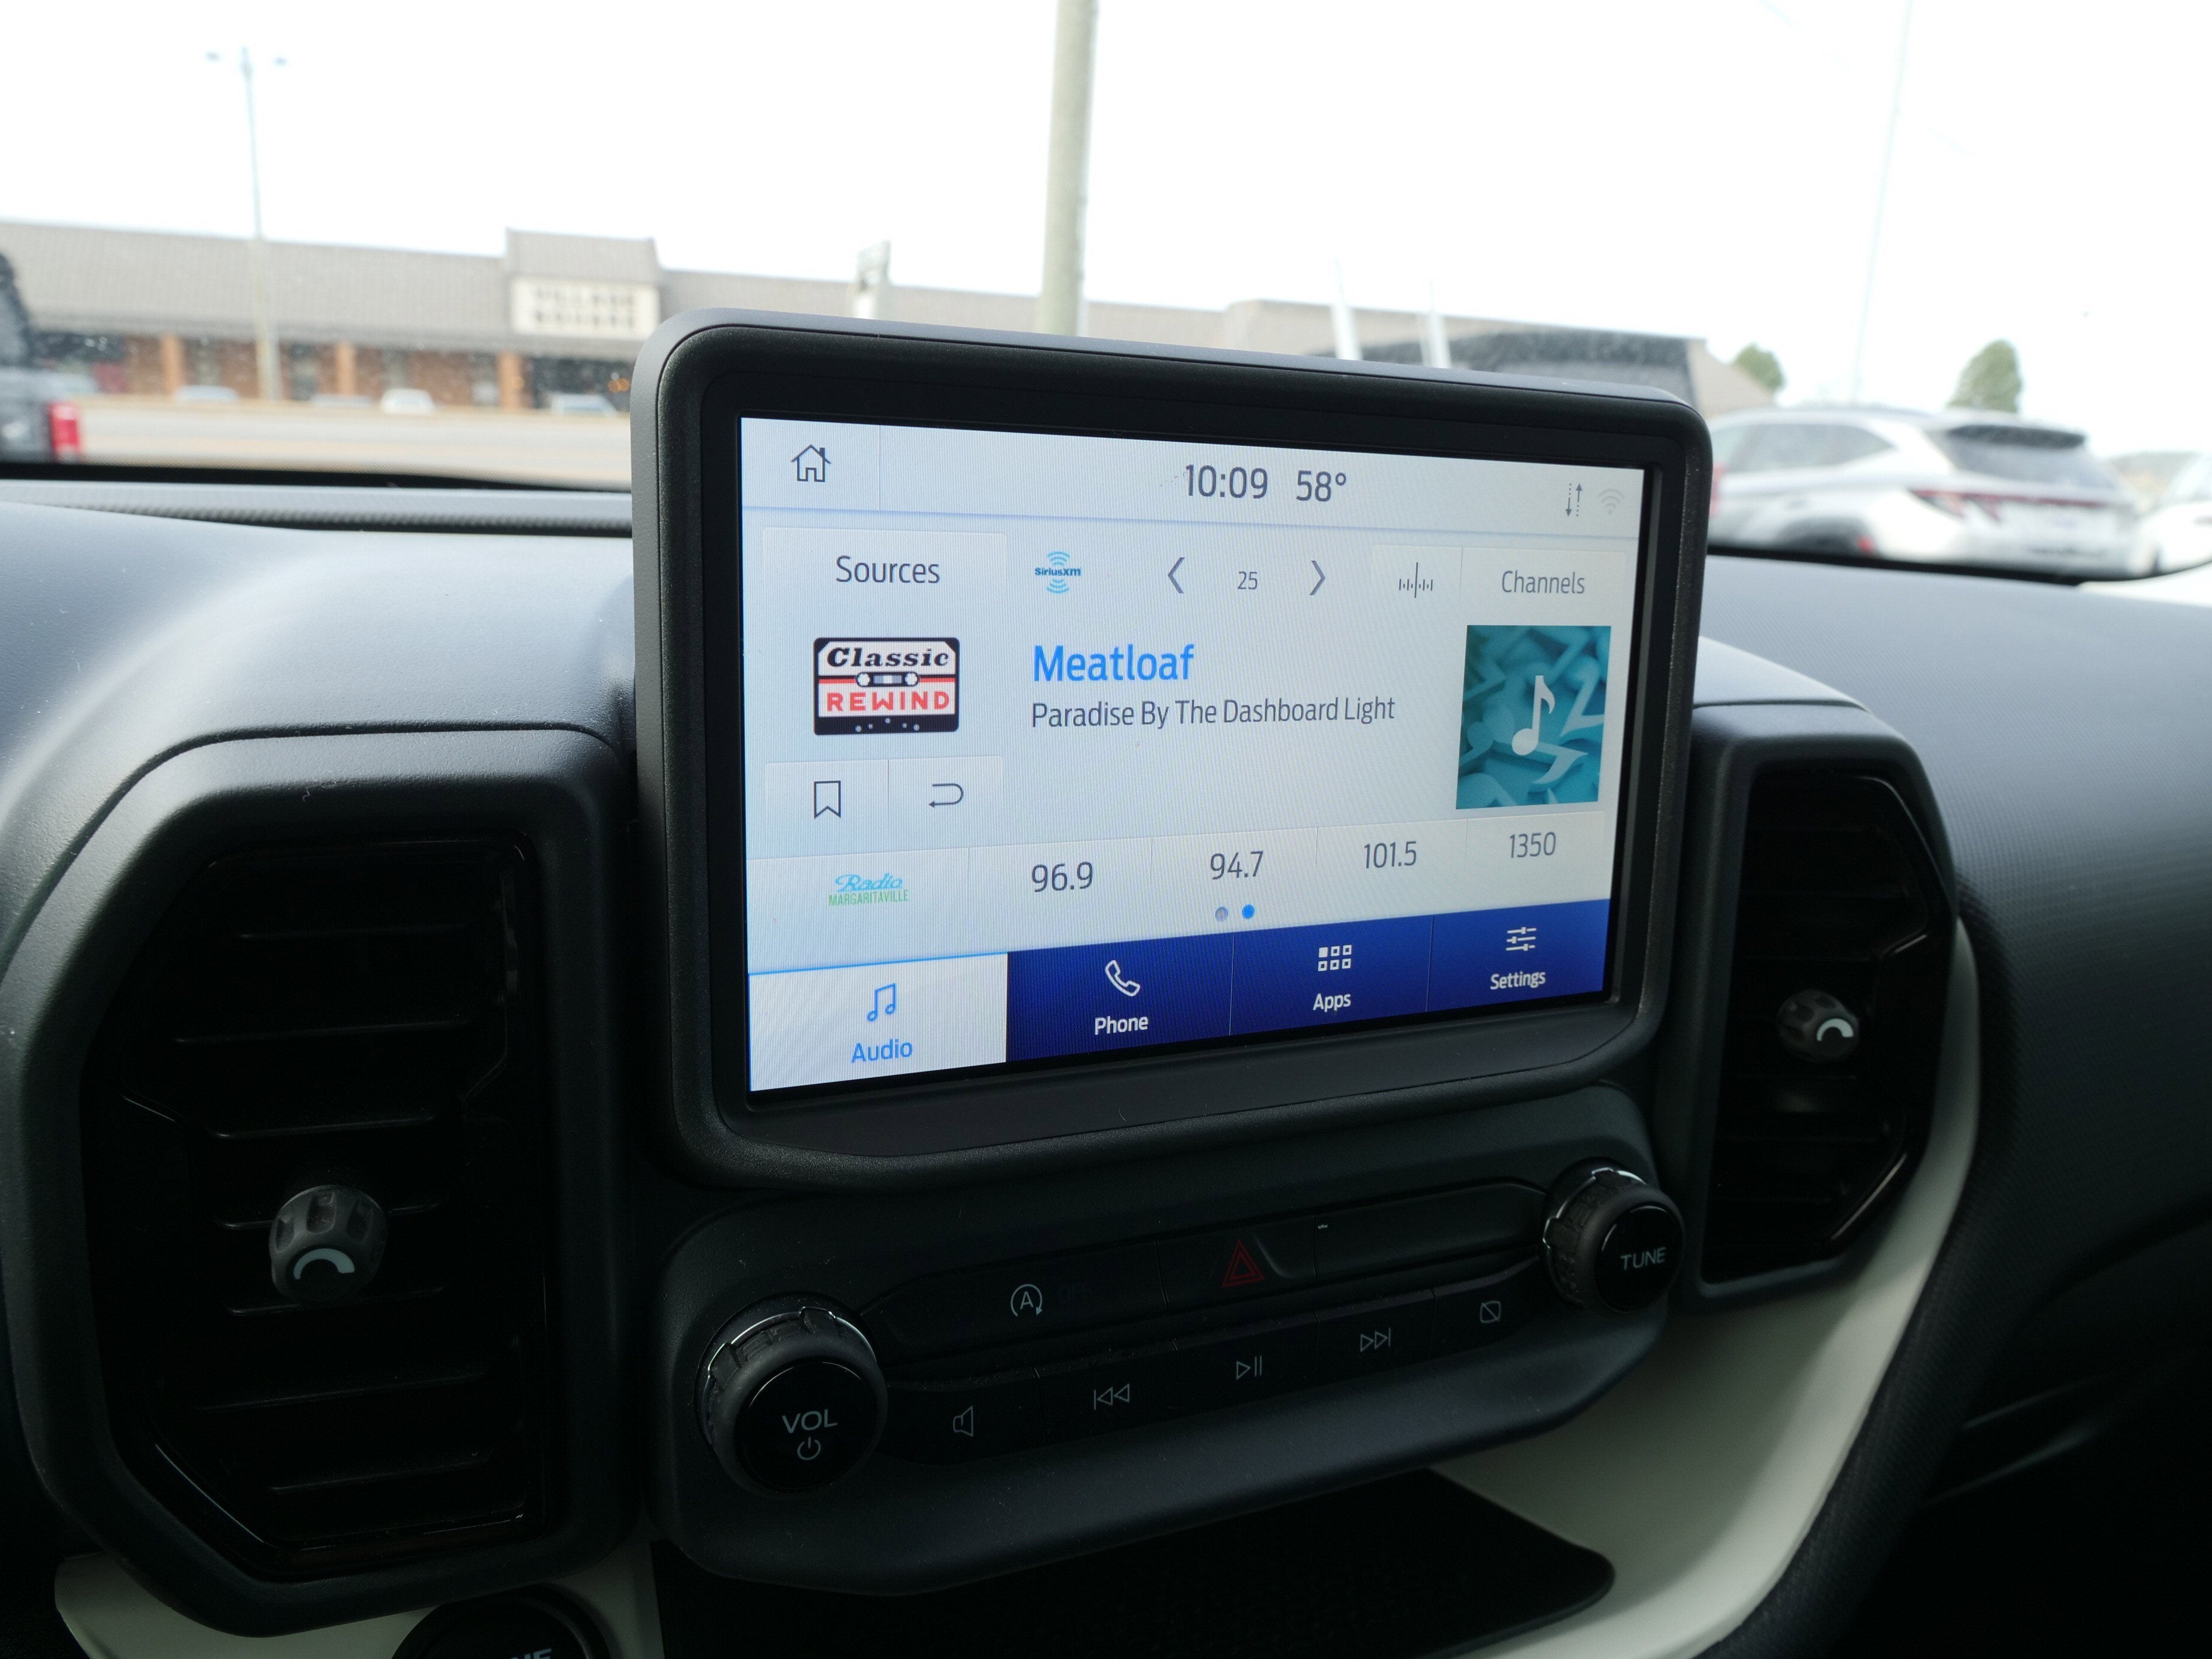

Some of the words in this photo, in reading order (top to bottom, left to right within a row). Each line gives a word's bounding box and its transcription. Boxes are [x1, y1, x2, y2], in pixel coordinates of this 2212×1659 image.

[1185, 464, 1269, 499] 10:09
[1295, 470, 1347, 502] 58°
[835, 555, 941, 585] Sources
[1237, 570, 1259, 591] 25
[1500, 569, 1585, 595] Channels
[826, 645, 950, 669] Classic
[1032, 644, 1195, 682] Meatloaf
[826, 690, 950, 713] REWIND
[1032, 700, 1135, 728] Paradise
[1141, 702, 1169, 729] By
[1174, 698, 1217, 725] The
[1223, 697, 1338, 723] Dashboard
[1344, 695, 1396, 725] Light
[1363, 840, 1418, 869] 101.5
[1509, 831, 1557, 859] 1350
[1031, 860, 1095, 893] 96.9
[1209, 850, 1264, 880] 94.7
[834, 872, 905, 892] Radio
[828, 889, 908, 906] MARGARITAVILLE
[1490, 970, 1546, 991] Settings
[1313, 992, 1352, 1013] Apps
[1094, 1014, 1150, 1036] Phone
[850, 1037, 914, 1064] Audio
[1620, 1246, 1667, 1271] TUNE
[781, 1408, 838, 1434] VOL
